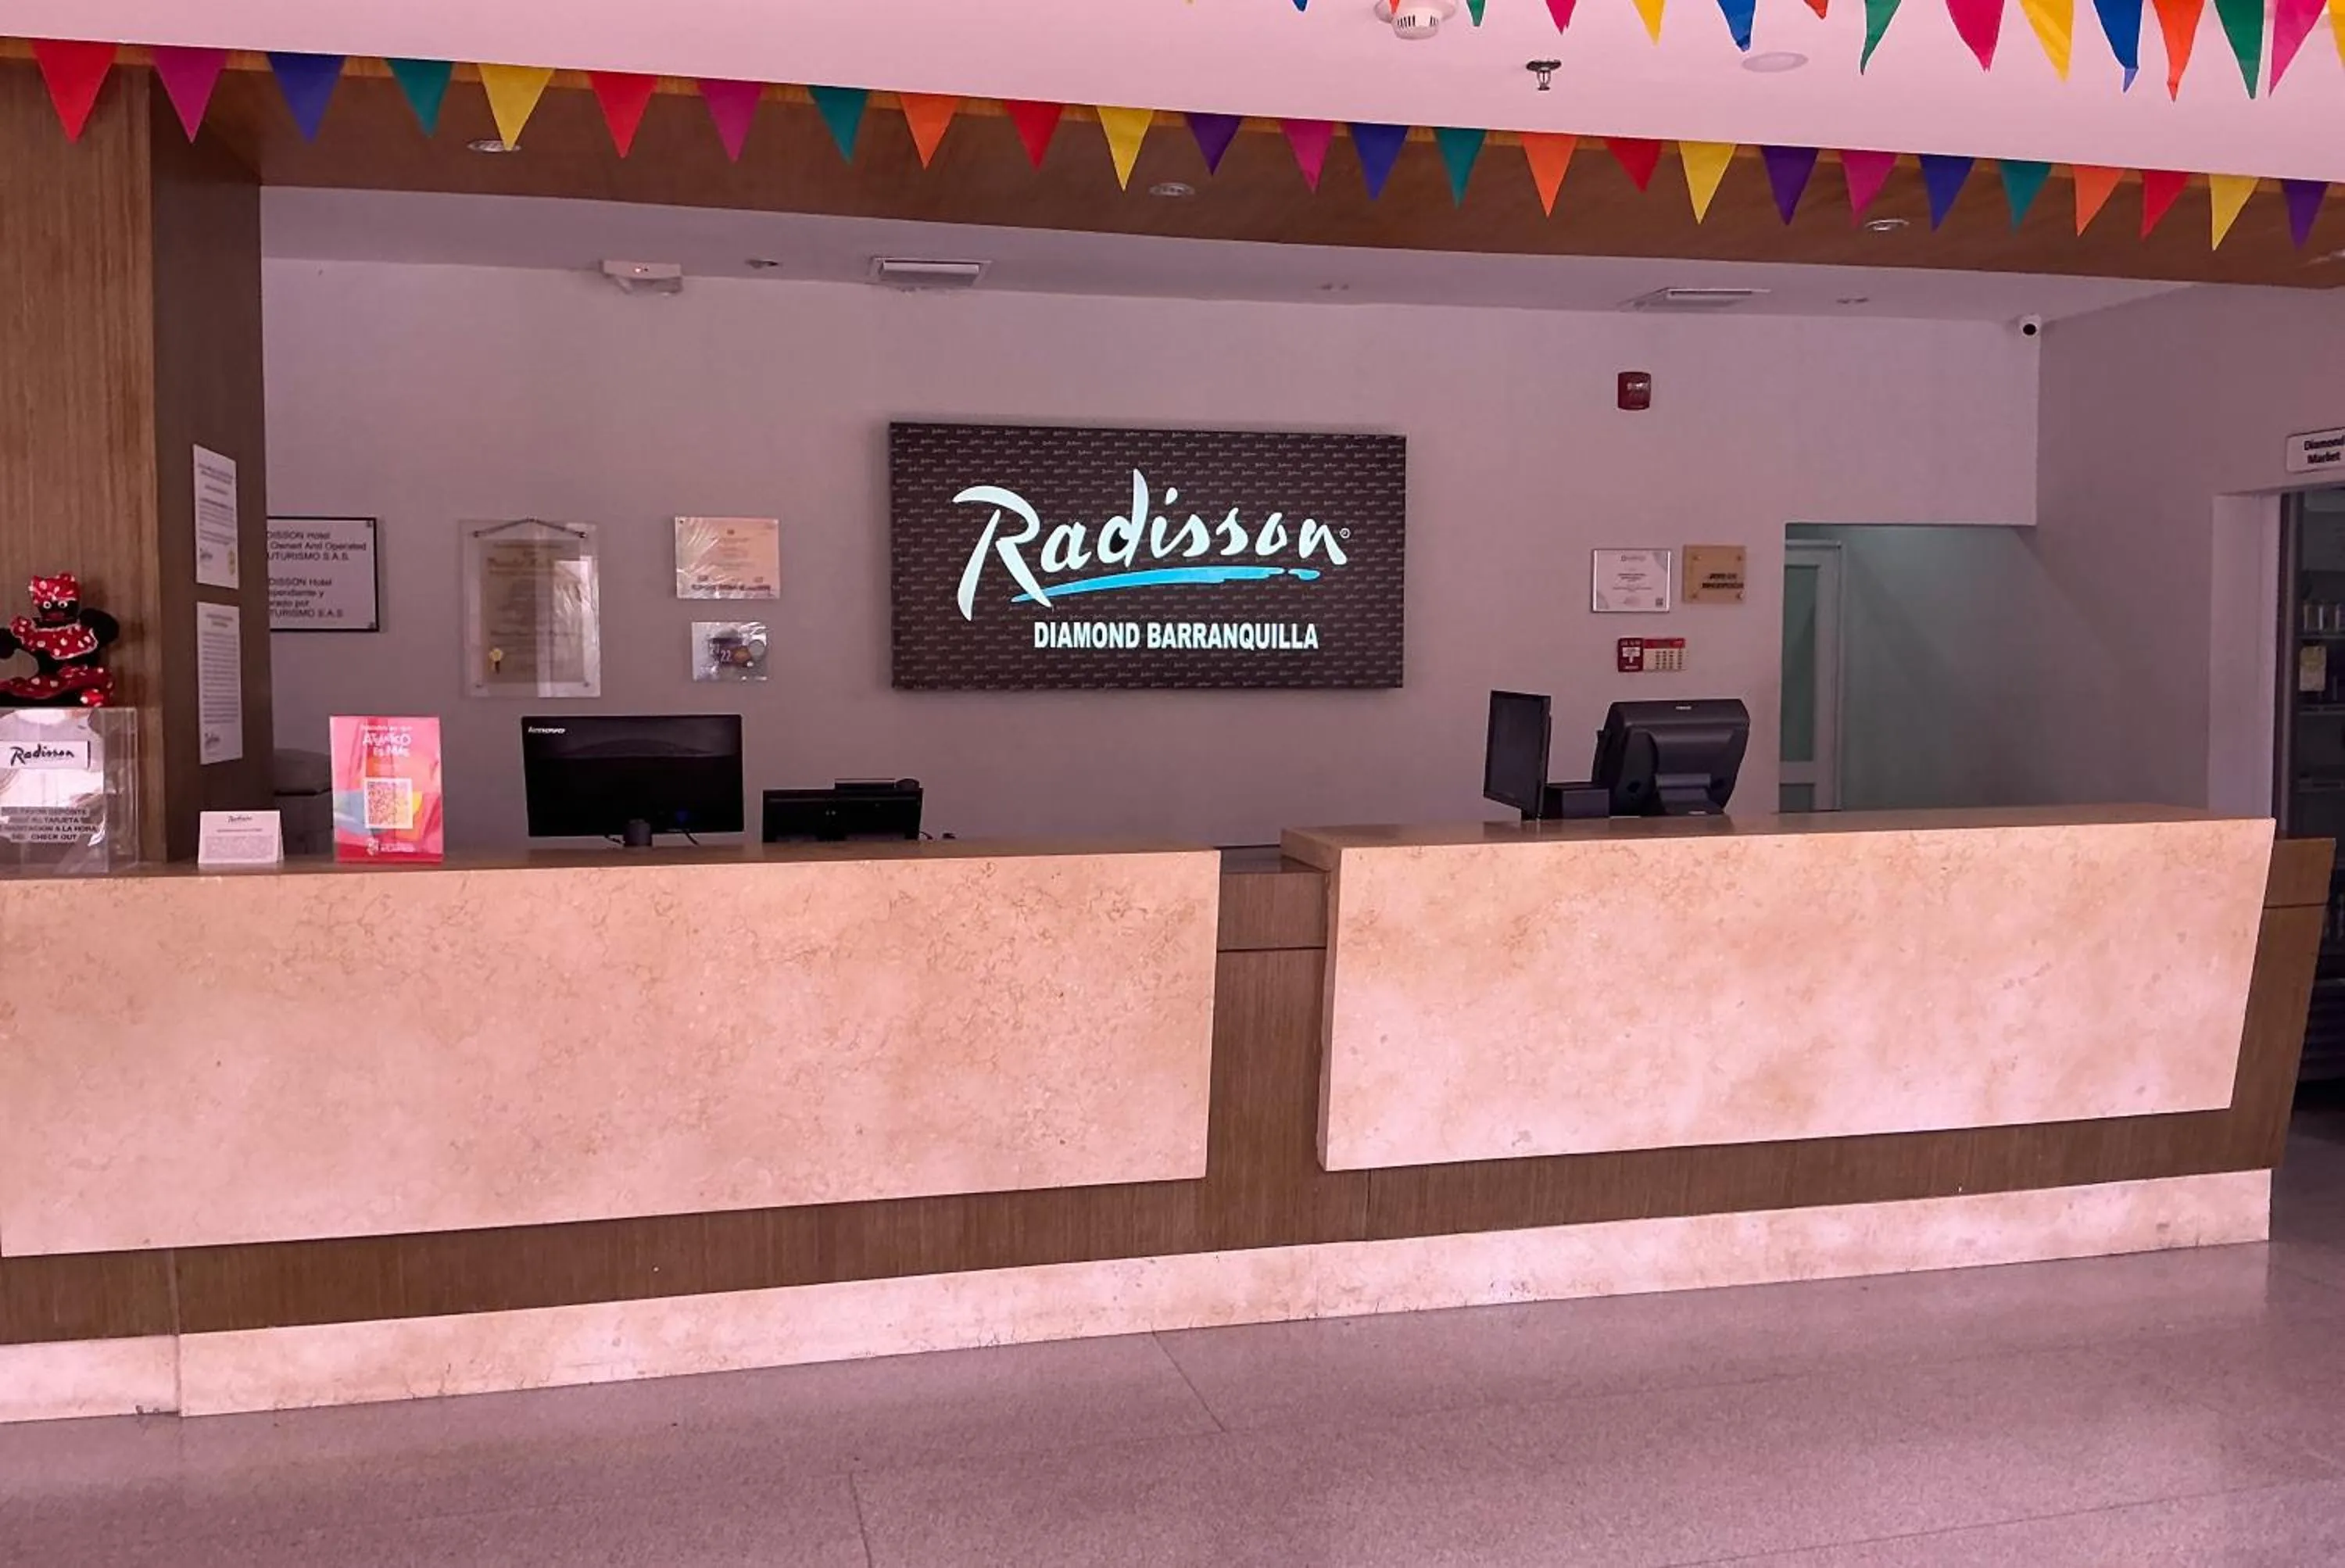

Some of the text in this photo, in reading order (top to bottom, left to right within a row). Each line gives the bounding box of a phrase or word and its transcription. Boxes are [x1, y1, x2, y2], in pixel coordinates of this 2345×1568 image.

[2304, 435, 2345, 450] Diamond
[2307, 452, 2340, 464] Market
[324, 542, 366, 551] Operated
[953, 469, 1347, 621] Radisson
[1033, 622, 1319, 650] DIAMOND BARRANQUILLA
[9, 743, 75, 766] Radisson
